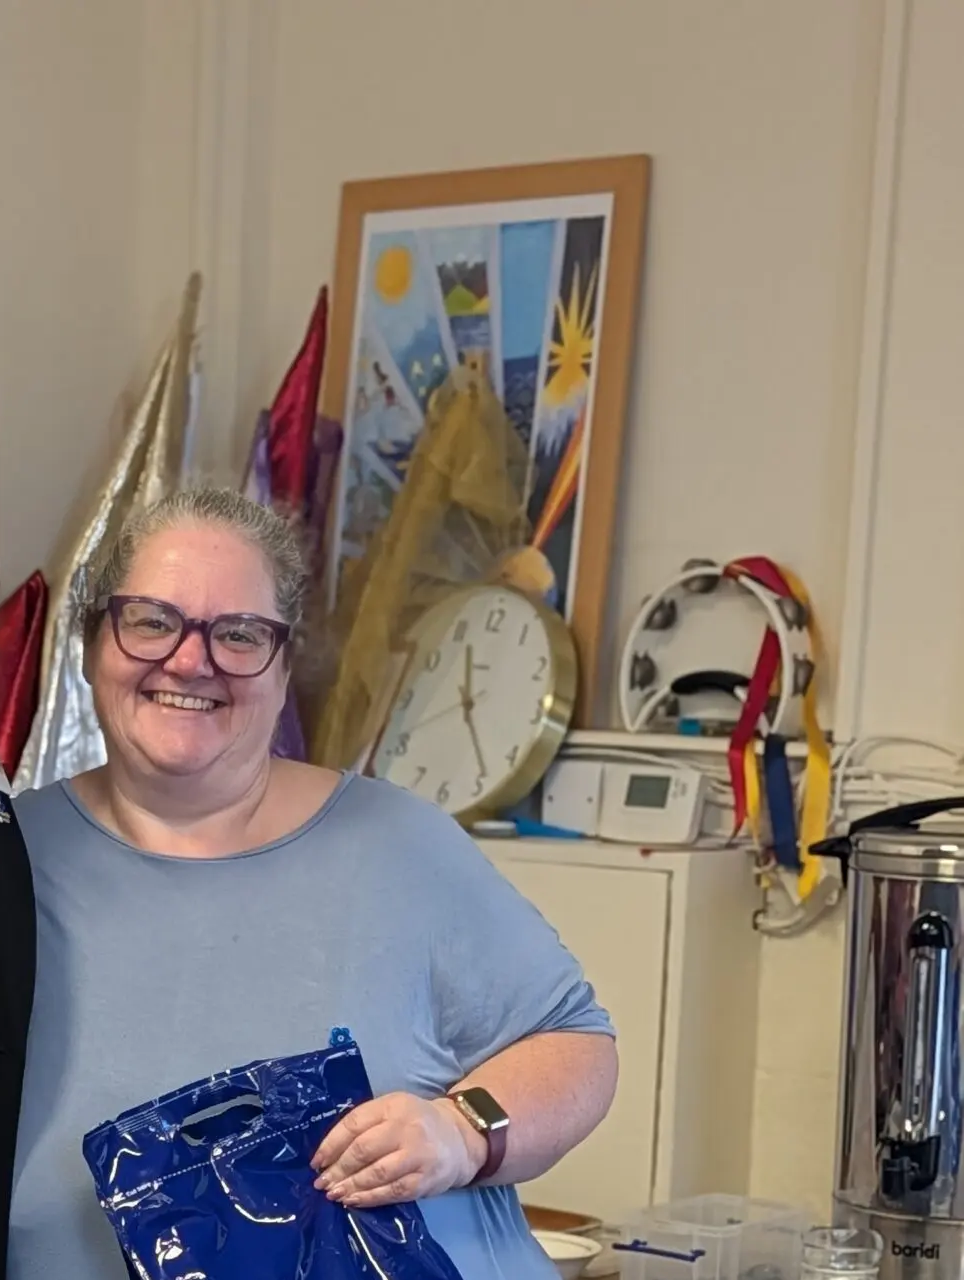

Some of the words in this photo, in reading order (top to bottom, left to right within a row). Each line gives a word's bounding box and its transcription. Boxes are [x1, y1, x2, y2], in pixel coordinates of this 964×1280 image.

[485, 608, 506, 633] 12
[518, 623, 529, 646] 1
[531, 656, 548, 682] 2
[505, 745, 520, 768] 4
[415, 766, 428, 787] 7
[438, 781, 451, 805] 6
[891, 1241, 940, 1260] baridi
